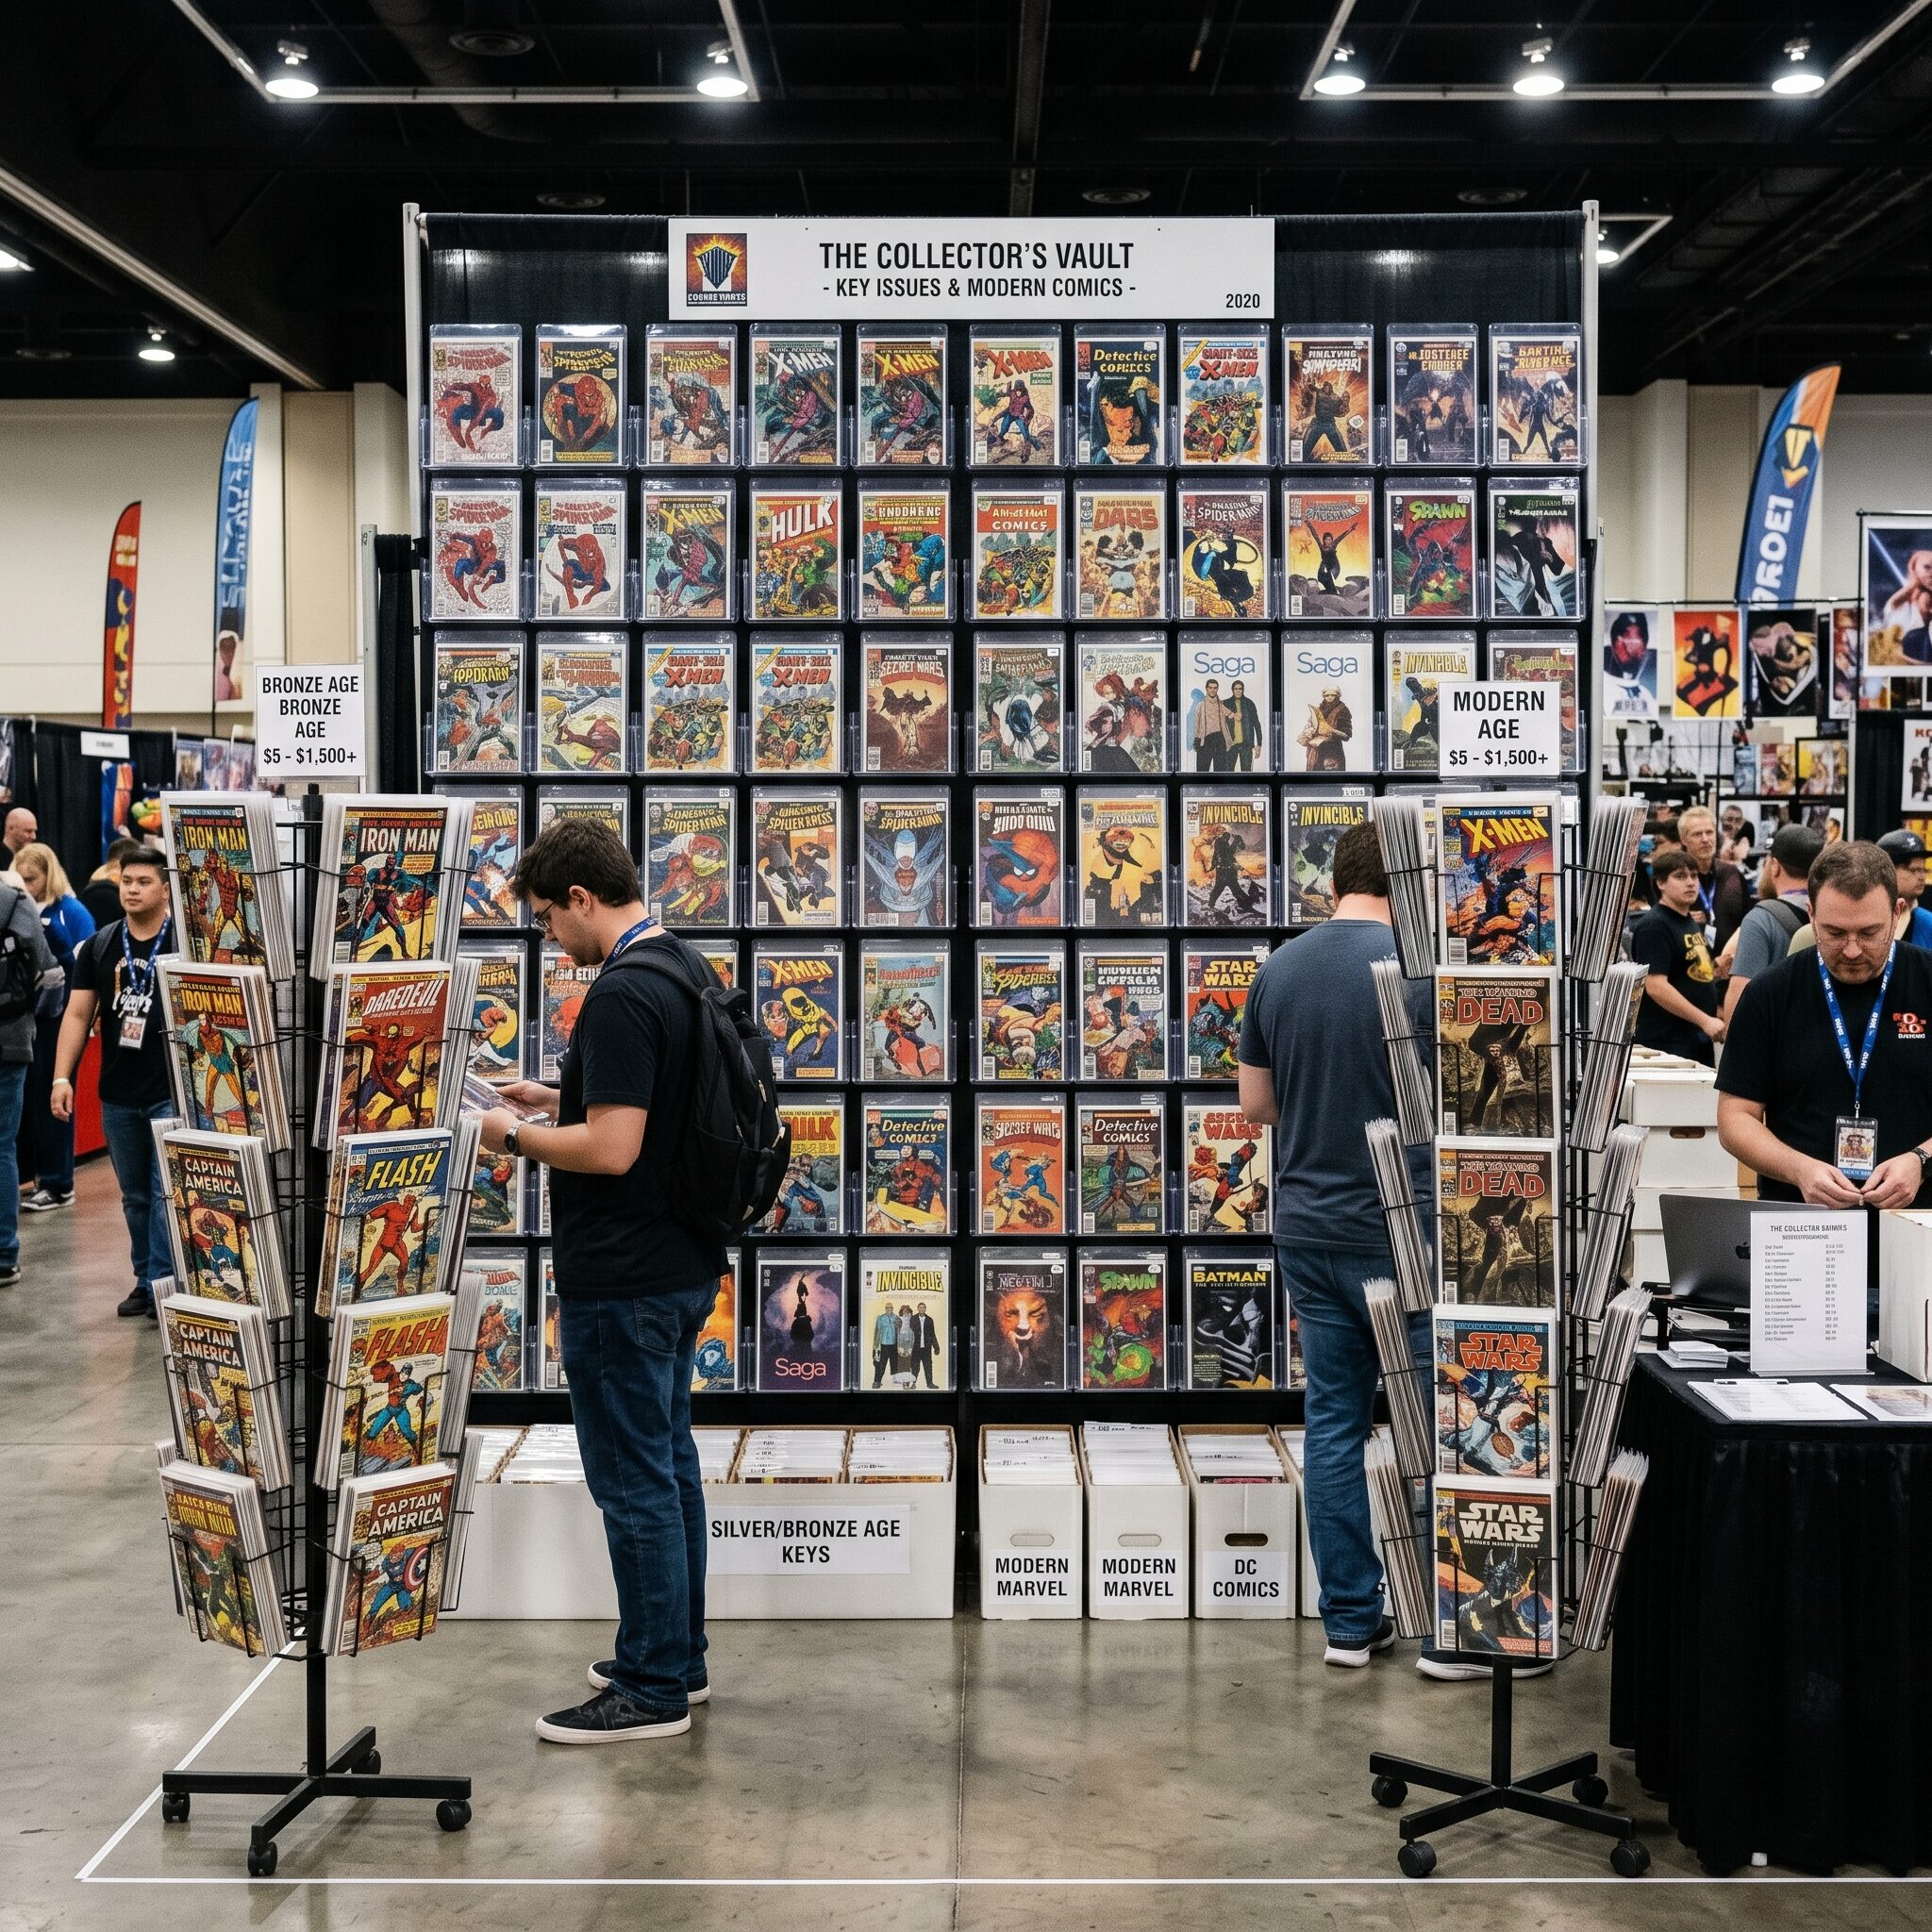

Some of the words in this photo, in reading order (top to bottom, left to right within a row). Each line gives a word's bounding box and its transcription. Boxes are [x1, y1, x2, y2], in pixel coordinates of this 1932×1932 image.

[819, 242, 868, 269] THE
[875, 242, 1048, 269] COLLECTOR'S
[1055, 242, 1135, 269] VAULT
[836, 278, 871, 297] KEY
[876, 278, 941, 297] ISSUES
[948, 278, 960, 297] &
[967, 278, 1046, 297] MODERN
[1052, 278, 1124, 297] COMICS
[1225, 293, 1260, 308] 2020
[771, 501, 835, 544] HULK
[1193, 652, 1256, 677] Saga
[1297, 652, 1358, 677] Saga
[262, 676, 324, 694] BRONZE
[327, 675, 359, 693] AGE
[279, 699, 341, 715] BRONZE
[1453, 691, 1545, 711] MODERN
[294, 721, 326, 739] AGE
[1477, 719, 1521, 739] AGE
[263, 748, 281, 765] $5
[295, 747, 358, 766] $1,500+
[1449, 750, 1468, 766] $5
[1484, 749, 1549, 766] $1,500+
[183, 826, 215, 850] IRON
[217, 827, 248, 851] MAN
[359, 828, 402, 853] IRON
[404, 828, 441, 852] MAN
[1461, 818, 1549, 856] X-MEN
[1206, 960, 1257, 973] STAR
[180, 989, 212, 1013] IRON
[214, 991, 243, 1015] MAN
[362, 979, 446, 1017] DAREDEVIL
[1457, 997, 1543, 1025] DEAD
[786, 1117, 838, 1141] ULK
[882, 1119, 945, 1132] Detective
[1094, 1119, 1158, 1132] Detective
[184, 1158, 236, 1178] CAPTAIN
[364, 1150, 444, 1191] FLASH
[184, 1176, 243, 1196] AMERICA
[1459, 1170, 1545, 1198] DEAD
[1192, 1271, 1267, 1283] BATMAN
[178, 1323, 234, 1348] CAPTAIN
[1459, 1332, 1542, 1353] STAR
[182, 1343, 242, 1367] AMERICA
[1460, 1351, 1542, 1372] WARS
[774, 1358, 827, 1380] Saga
[376, 1491, 442, 1518] CAPTAIN
[1458, 1502, 1544, 1524] STAR
[368, 1506, 444, 1537] AMERICA
[711, 1520, 858, 1539] SILVER/BRONZE
[863, 1520, 901, 1538] AGE
[1459, 1521, 1544, 1543] WARS
[781, 1545, 831, 1563] KEYS
[994, 1557, 1070, 1574] MODERN
[1101, 1558, 1176, 1574] MODERN
[1234, 1558, 1258, 1575] DC
[996, 1581, 1068, 1597] MARVEL
[1103, 1581, 1174, 1597] MARVEL
[1212, 1581, 1280, 1598] COMICS
